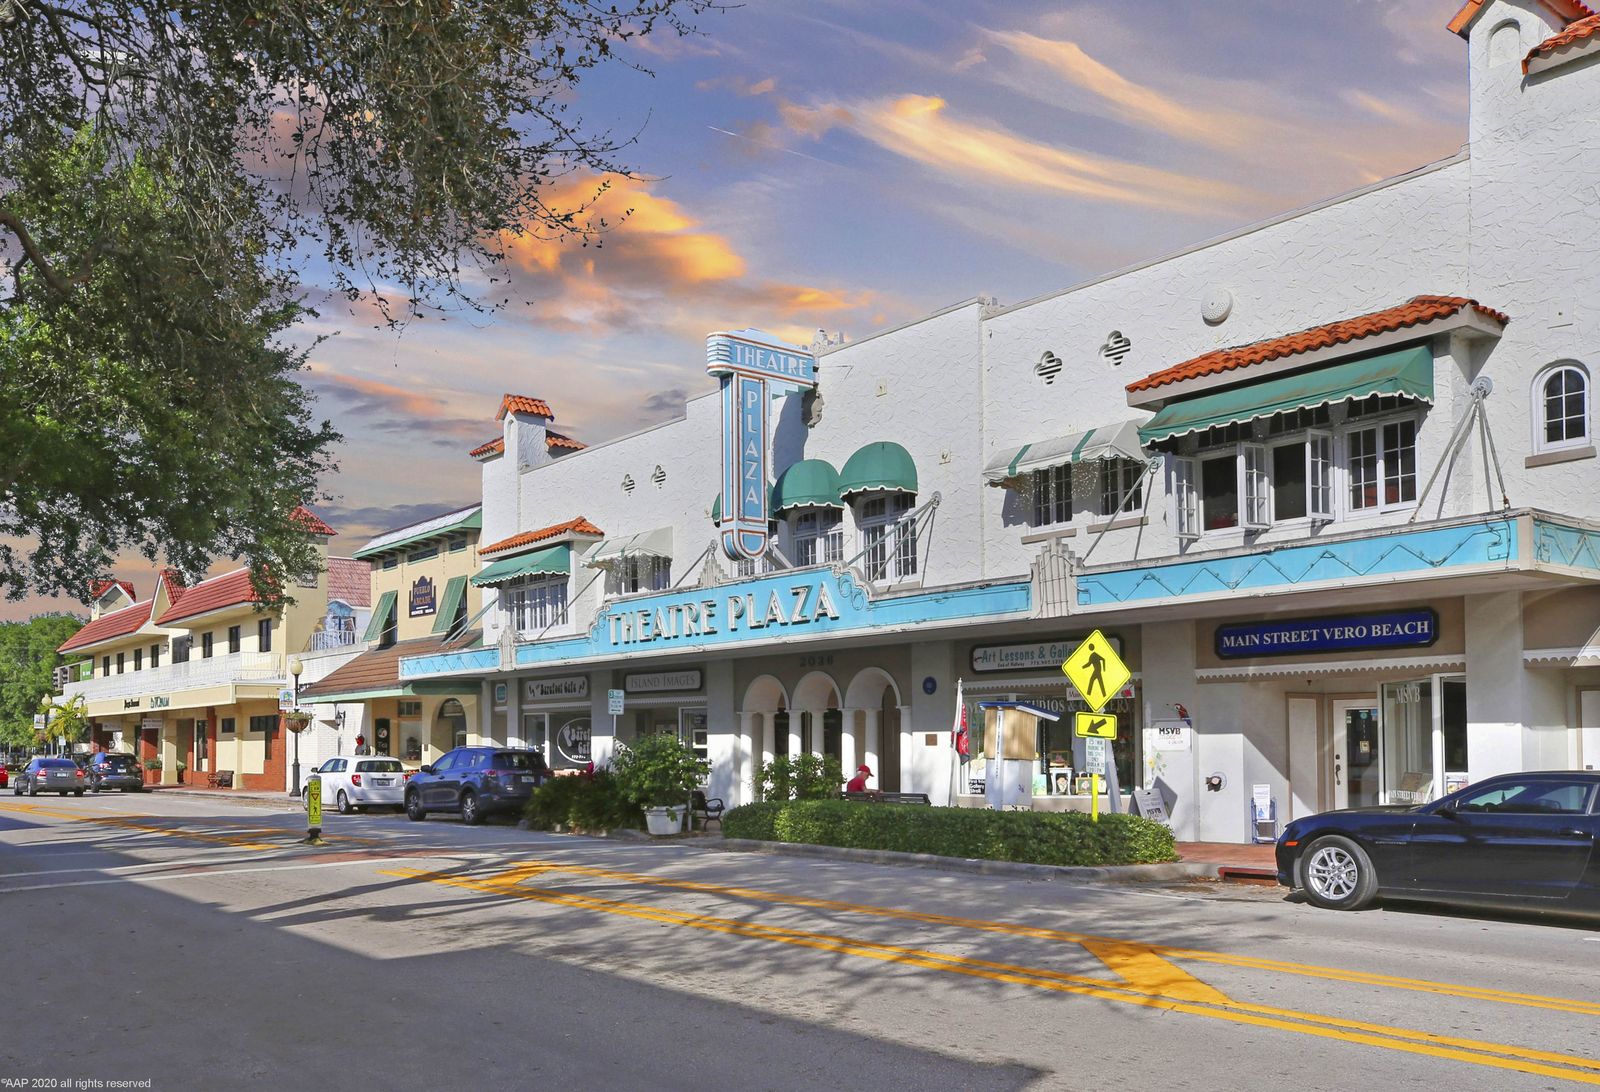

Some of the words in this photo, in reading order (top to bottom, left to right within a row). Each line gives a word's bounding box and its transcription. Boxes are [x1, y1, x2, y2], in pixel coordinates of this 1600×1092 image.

[735, 345, 807, 377] THEATRE
[745, 390, 759, 504] PLAZA
[608, 600, 717, 645] THEATRE
[728, 581, 839, 631] PLAZA
[1223, 634, 1260, 647] MAIN
[1263, 629, 1319, 645] STREET
[1323, 625, 1367, 640] VERO
[1371, 621, 1429, 637] BEACH
[982, 650, 996, 663] Art
[999, 648, 1034, 661] Lessons
[1038, 646, 1046, 659] &
[1050, 645, 1074, 658] Galle
[540, 683, 562, 695] Barefoot
[631, 677, 659, 688] ISLAND
[663, 674, 695, 687] IMAGES
[1397, 686, 1420, 704] MSVB
[1024, 699, 1065, 712] TUDIOS
[571, 729, 591, 741] Baref
